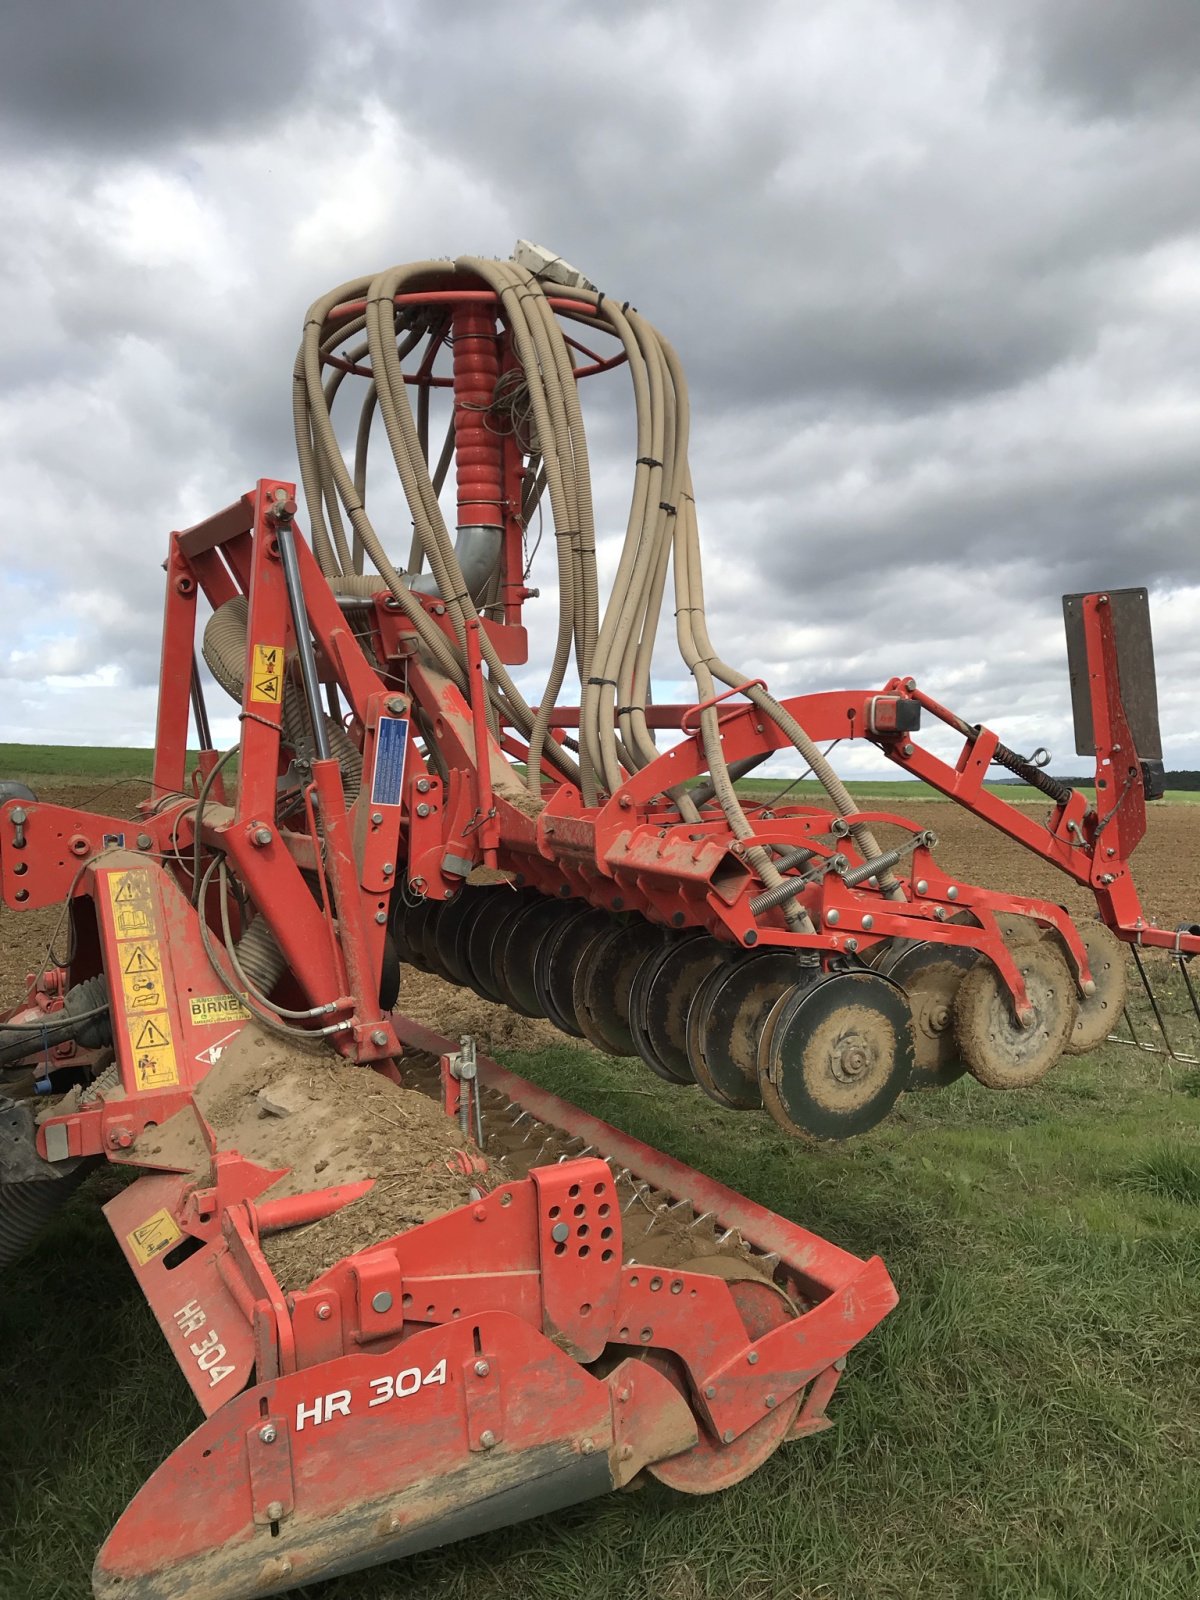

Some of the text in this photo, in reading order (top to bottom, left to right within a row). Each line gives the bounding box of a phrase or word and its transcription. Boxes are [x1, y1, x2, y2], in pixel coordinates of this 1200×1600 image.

[173, 1299, 236, 1388] HR 304
[296, 1358, 447, 1431] HR 304
